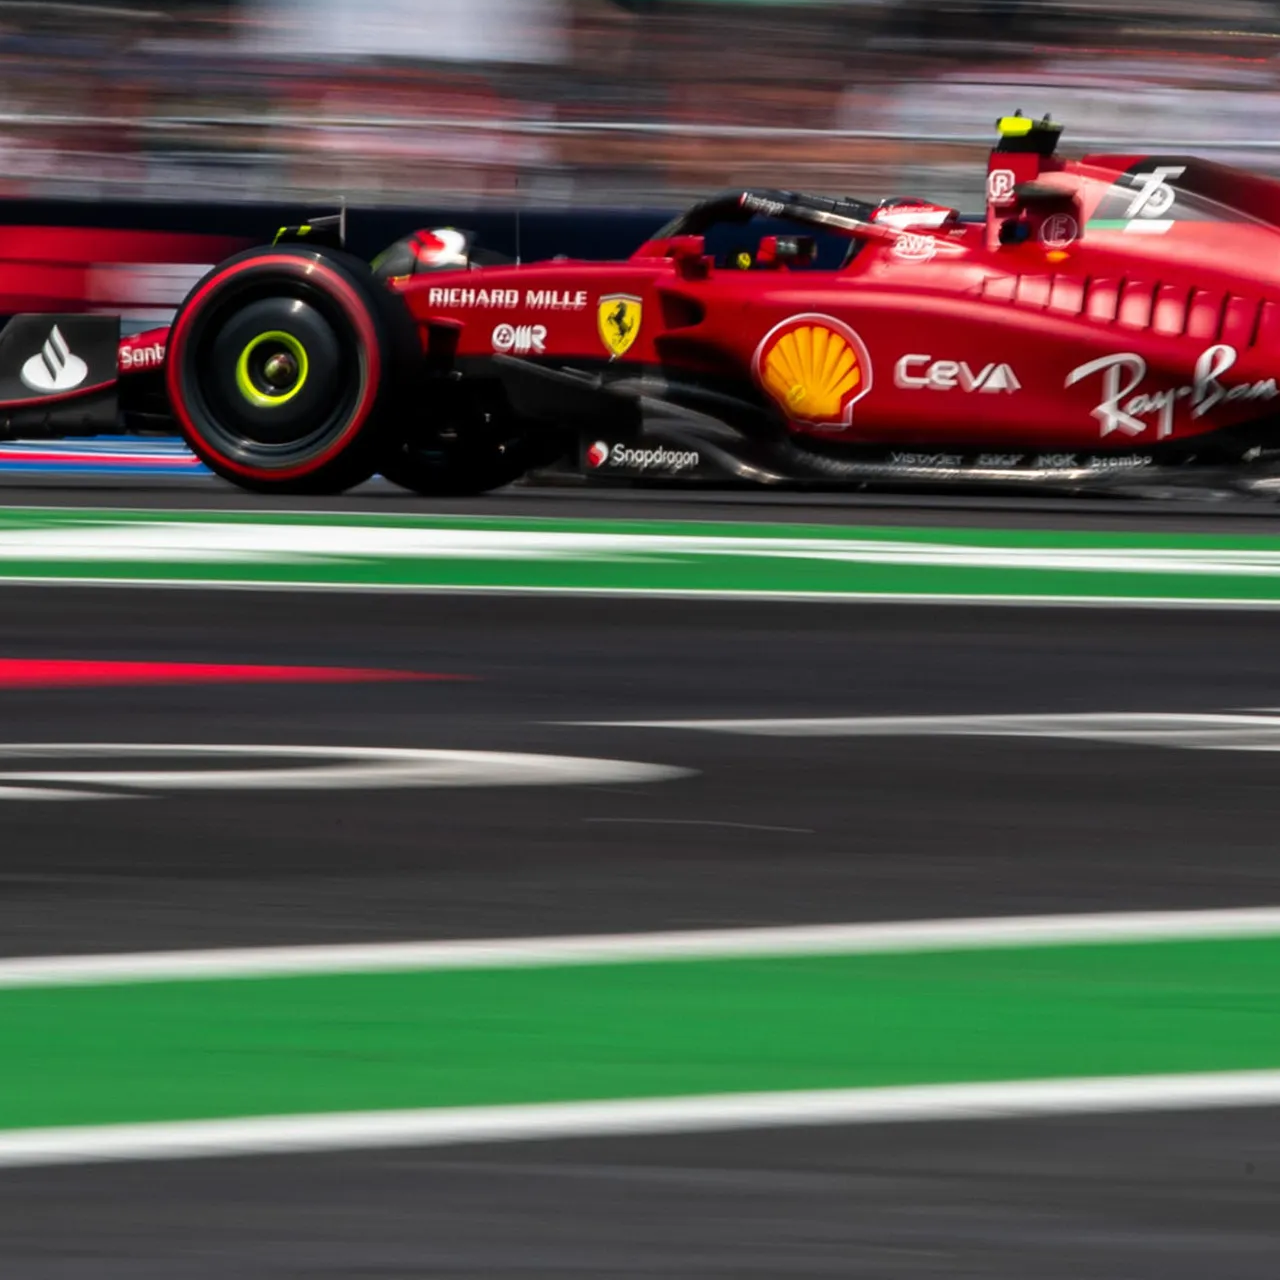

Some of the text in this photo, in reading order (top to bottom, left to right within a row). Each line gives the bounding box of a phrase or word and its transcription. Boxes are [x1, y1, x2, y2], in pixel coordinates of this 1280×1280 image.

[429, 287, 587, 310] RICHARD MILLE
[1065, 344, 1280, 439] Ray-Ban
[610, 443, 700, 472] Snapdragon
[1036, 453, 1077, 468] NGK
